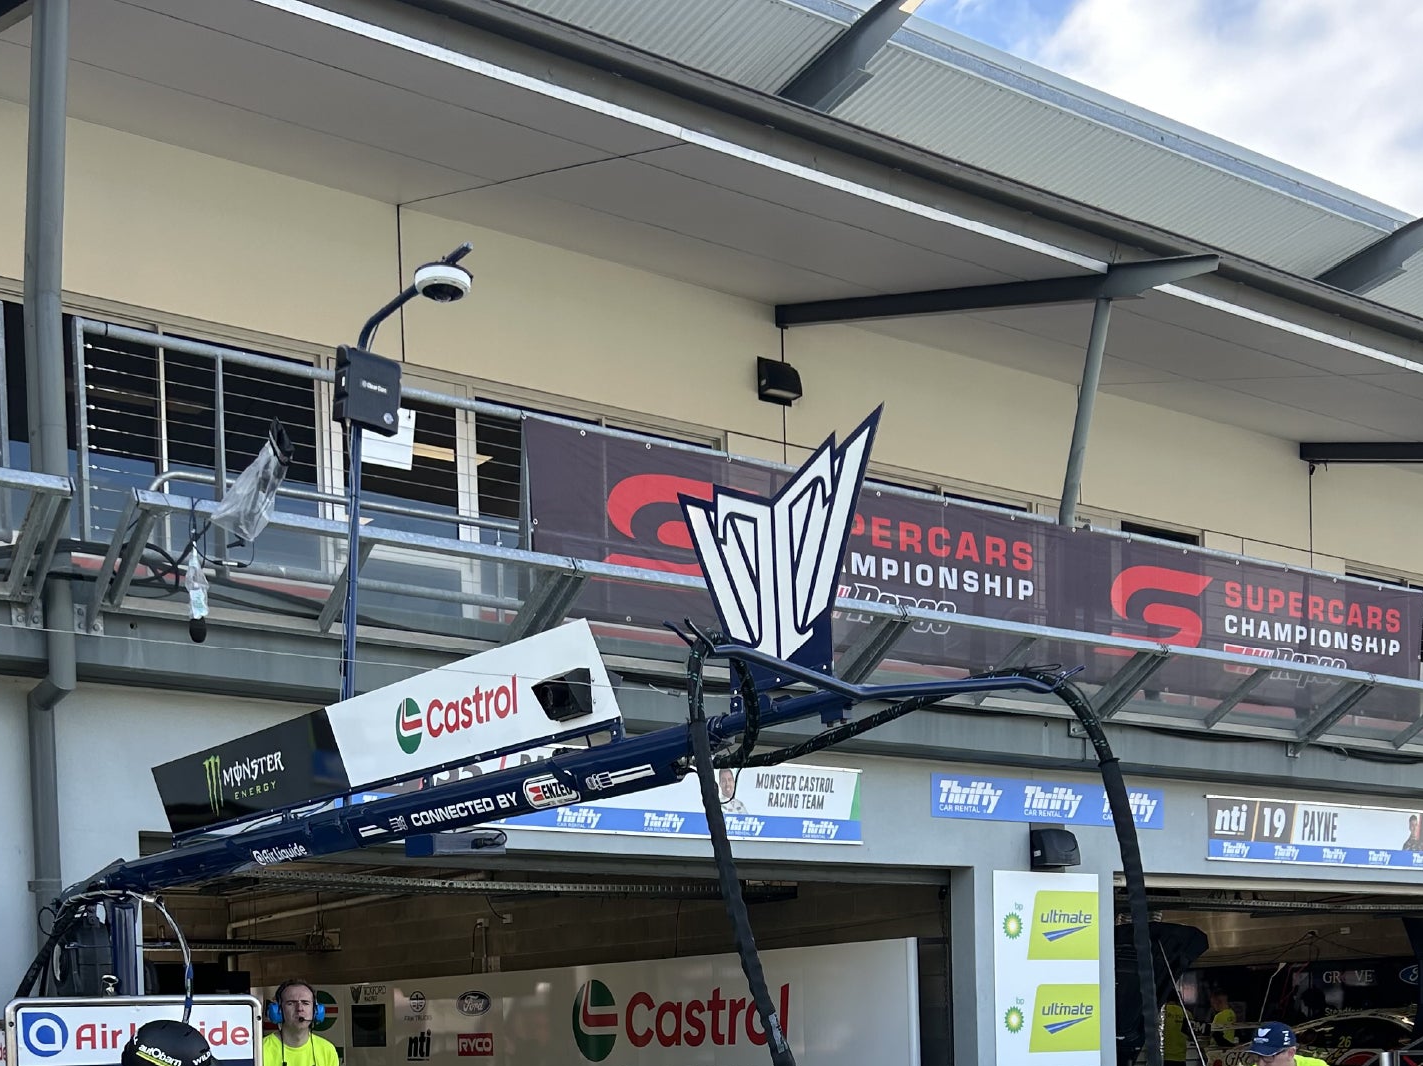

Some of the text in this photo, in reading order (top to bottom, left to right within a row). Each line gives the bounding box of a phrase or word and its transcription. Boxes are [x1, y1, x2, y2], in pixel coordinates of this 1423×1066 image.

[1224, 580, 1401, 633] SUPERCARS
[1224, 613, 1401, 656] CHAMPIONSHIP
[425, 673, 519, 738] Castrol
[222, 751, 285, 787] MONSTER
[234, 780, 277, 799] ENERGY
[755, 772, 835, 795] MONSTER CASTROL
[939, 779, 1003, 814] Thrifty
[410, 792, 517, 827] CONNECTED BY
[767, 791, 825, 810] RACING TEAM
[939, 804, 980, 813] CAR RENTAL
[1024, 785, 1083, 818] Thrifty
[1038, 810, 1062, 818] RENTAL
[556, 807, 602, 829] Thrifty
[644, 812, 685, 833] Thrifty
[802, 820, 839, 839] Thrifty
[1214, 804, 1248, 832] nti
[1263, 807, 1286, 838] 19
[1302, 810, 1338, 842] PAYNE
[1040, 909, 1092, 924] ultimate
[1041, 1002, 1094, 1016] ultimate
[76, 1023, 123, 1050] Air
[407, 1029, 431, 1057] nti
[458, 1037, 493, 1052] RYCO
